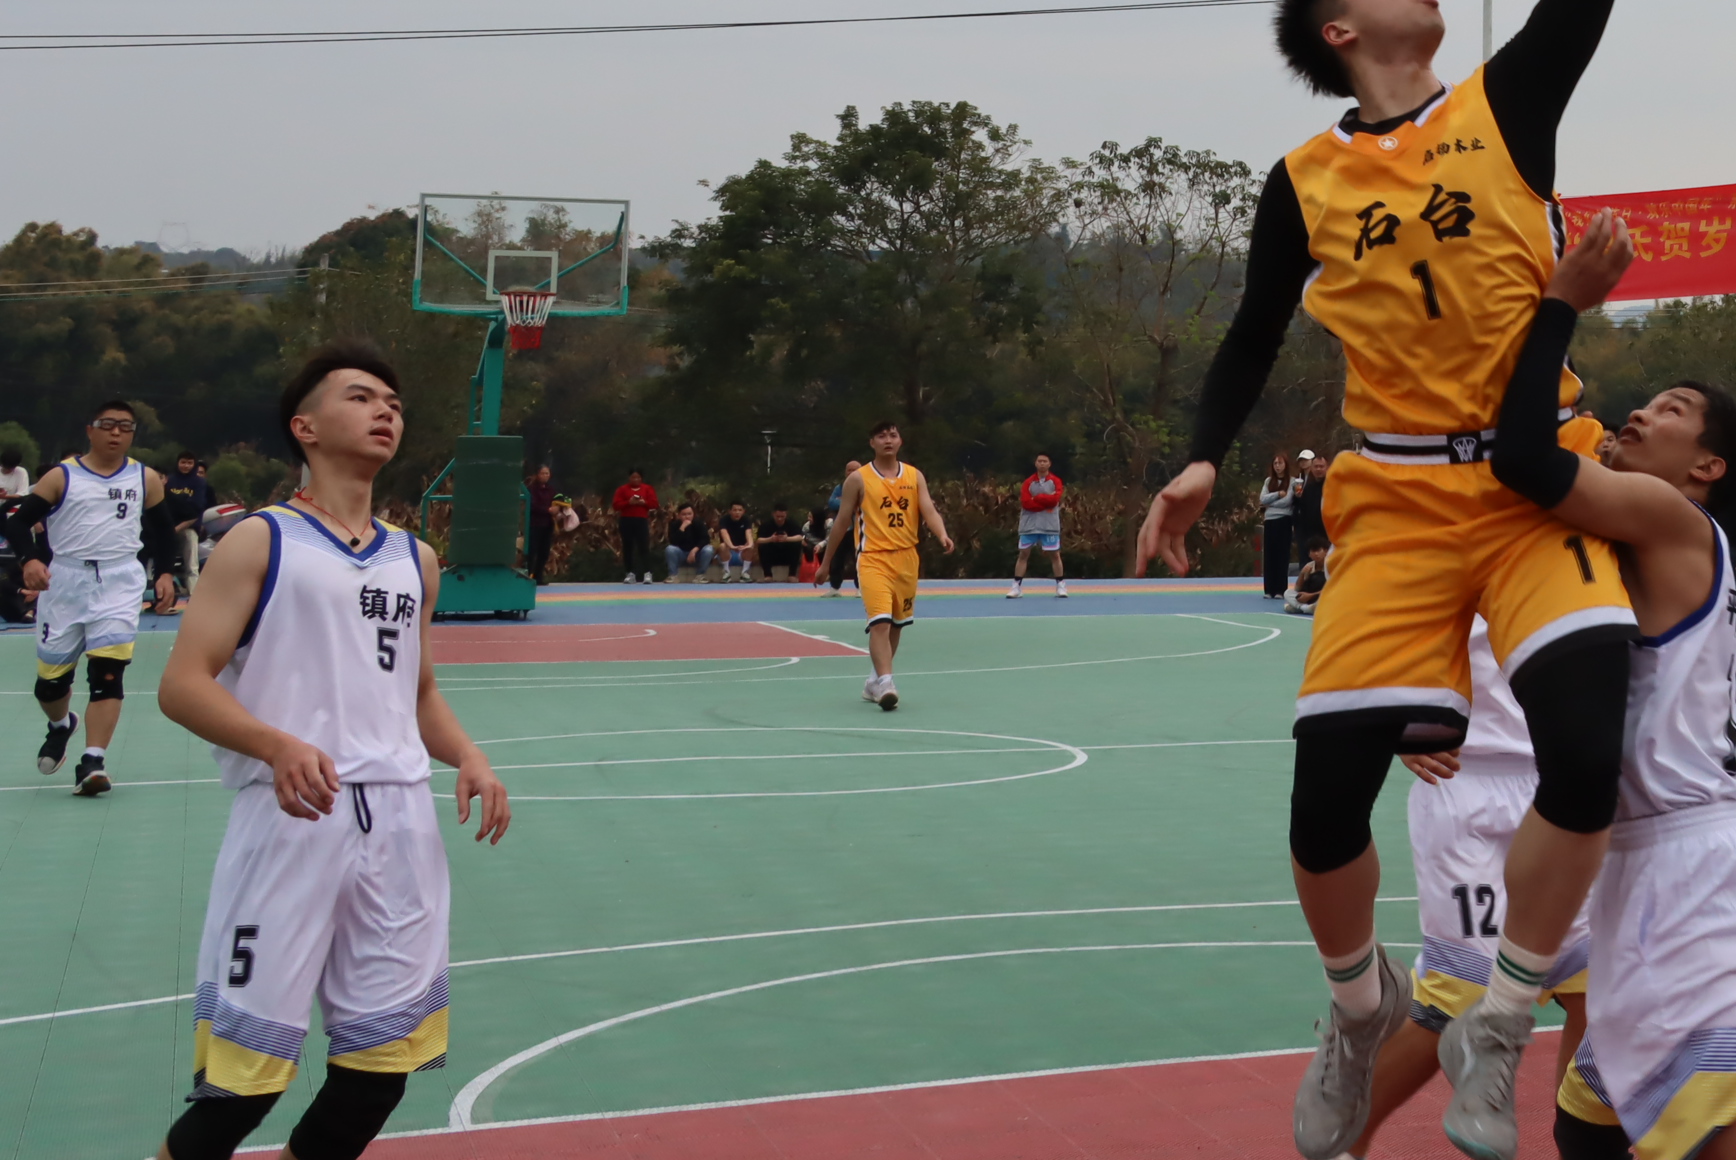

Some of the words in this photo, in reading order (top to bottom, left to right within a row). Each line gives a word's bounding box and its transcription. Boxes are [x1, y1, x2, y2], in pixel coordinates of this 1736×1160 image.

[1353, 183, 1476, 262] 石台
[1410, 259, 1442, 321] 1
[116, 502, 128, 520] 9
[880, 495, 909, 511] 石台
[887, 513, 904, 528] 25
[1563, 534, 1596, 585] 1
[359, 584, 416, 628] 镇府
[377, 626, 400, 674] 5
[1451, 883, 1500, 939] 12
[228, 924, 260, 988] 5
